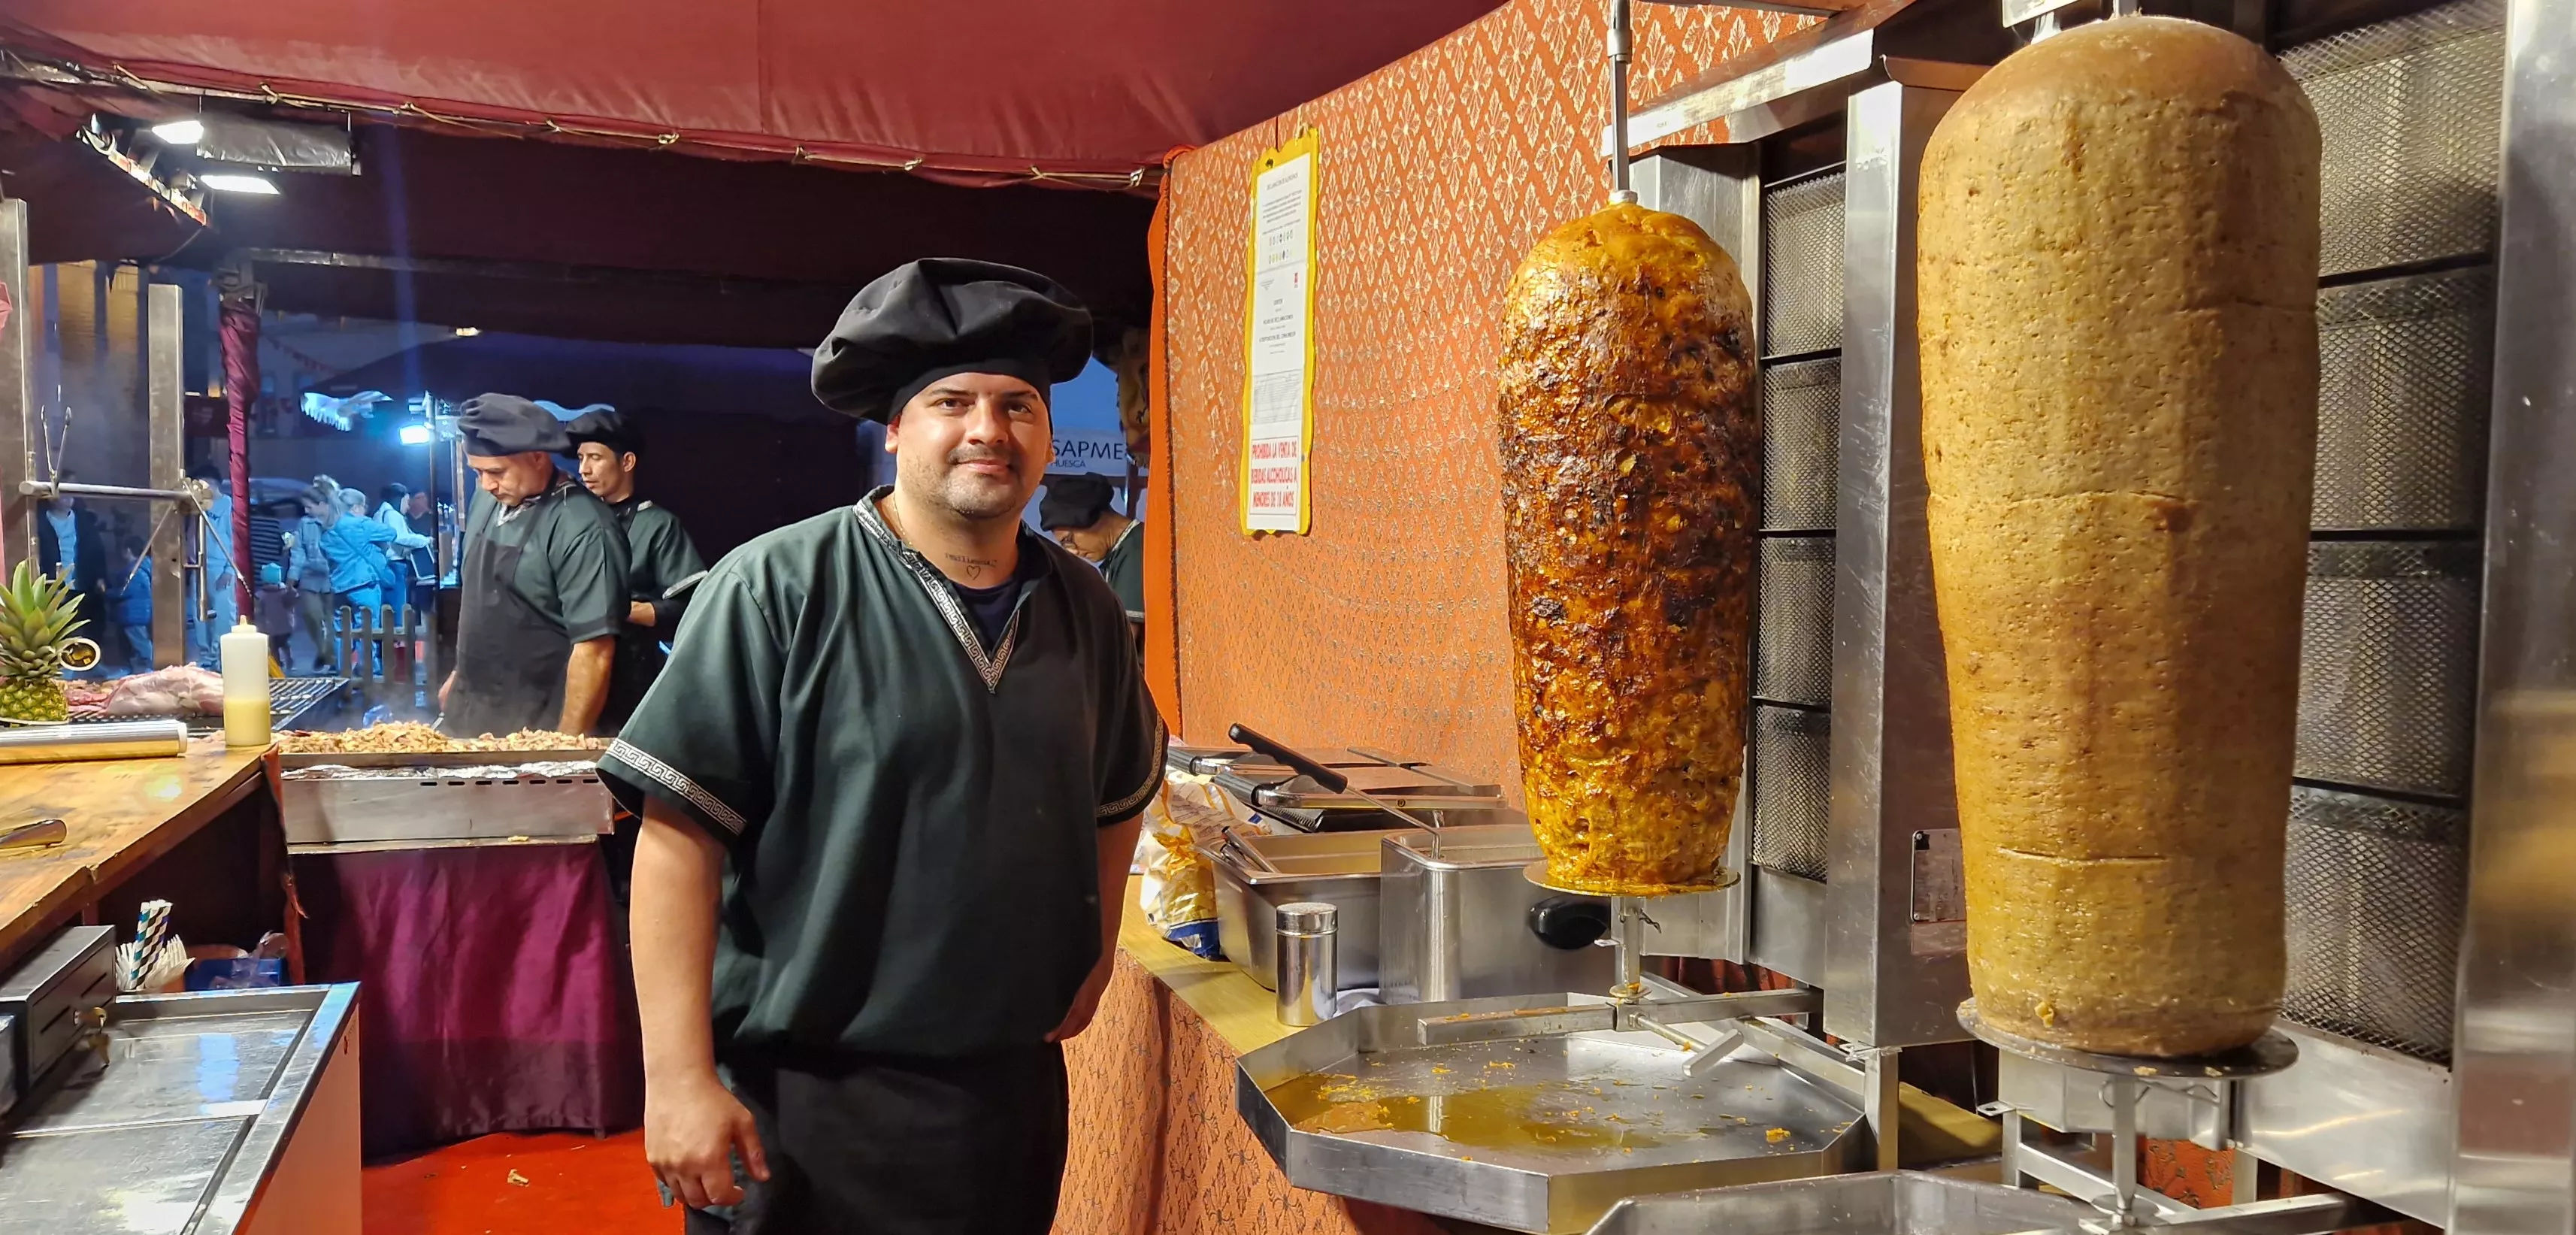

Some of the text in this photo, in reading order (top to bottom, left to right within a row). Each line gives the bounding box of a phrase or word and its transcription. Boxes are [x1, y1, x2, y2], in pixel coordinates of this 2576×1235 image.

[1252, 441, 1297, 459] PROHIBIDA LA VENTA DE
[1051, 459, 1086, 468] HUESCA
[1252, 468, 1266, 483] BEBIDAS
[1253, 491, 1270, 507] MENORES
[1271, 491, 1276, 507] DE
